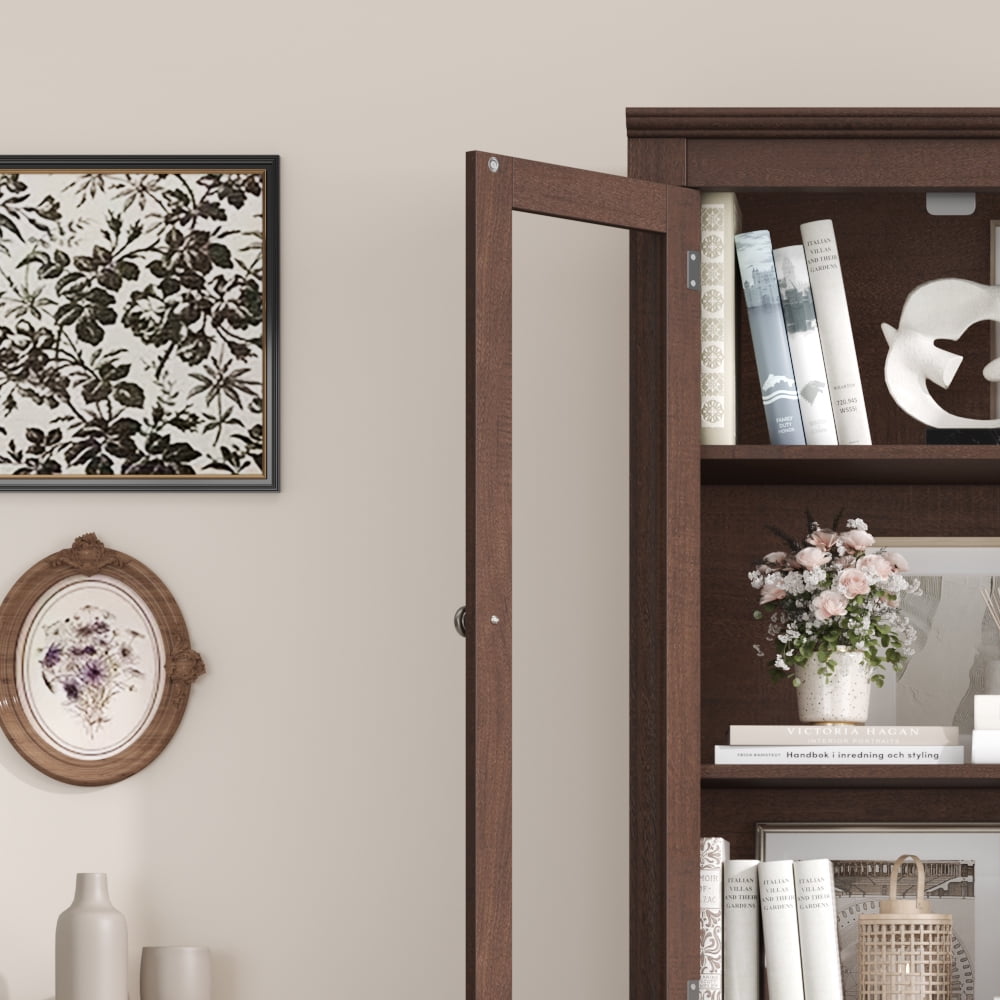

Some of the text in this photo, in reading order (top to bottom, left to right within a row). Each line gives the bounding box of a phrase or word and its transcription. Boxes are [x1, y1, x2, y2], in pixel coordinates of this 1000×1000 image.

[787, 727, 920, 736] VICTORIA HAGAN
[786, 751, 829, 759] Handbok
[838, 751, 884, 760] inredning
[887, 751, 904, 759] och
[907, 751, 940, 760] styling
